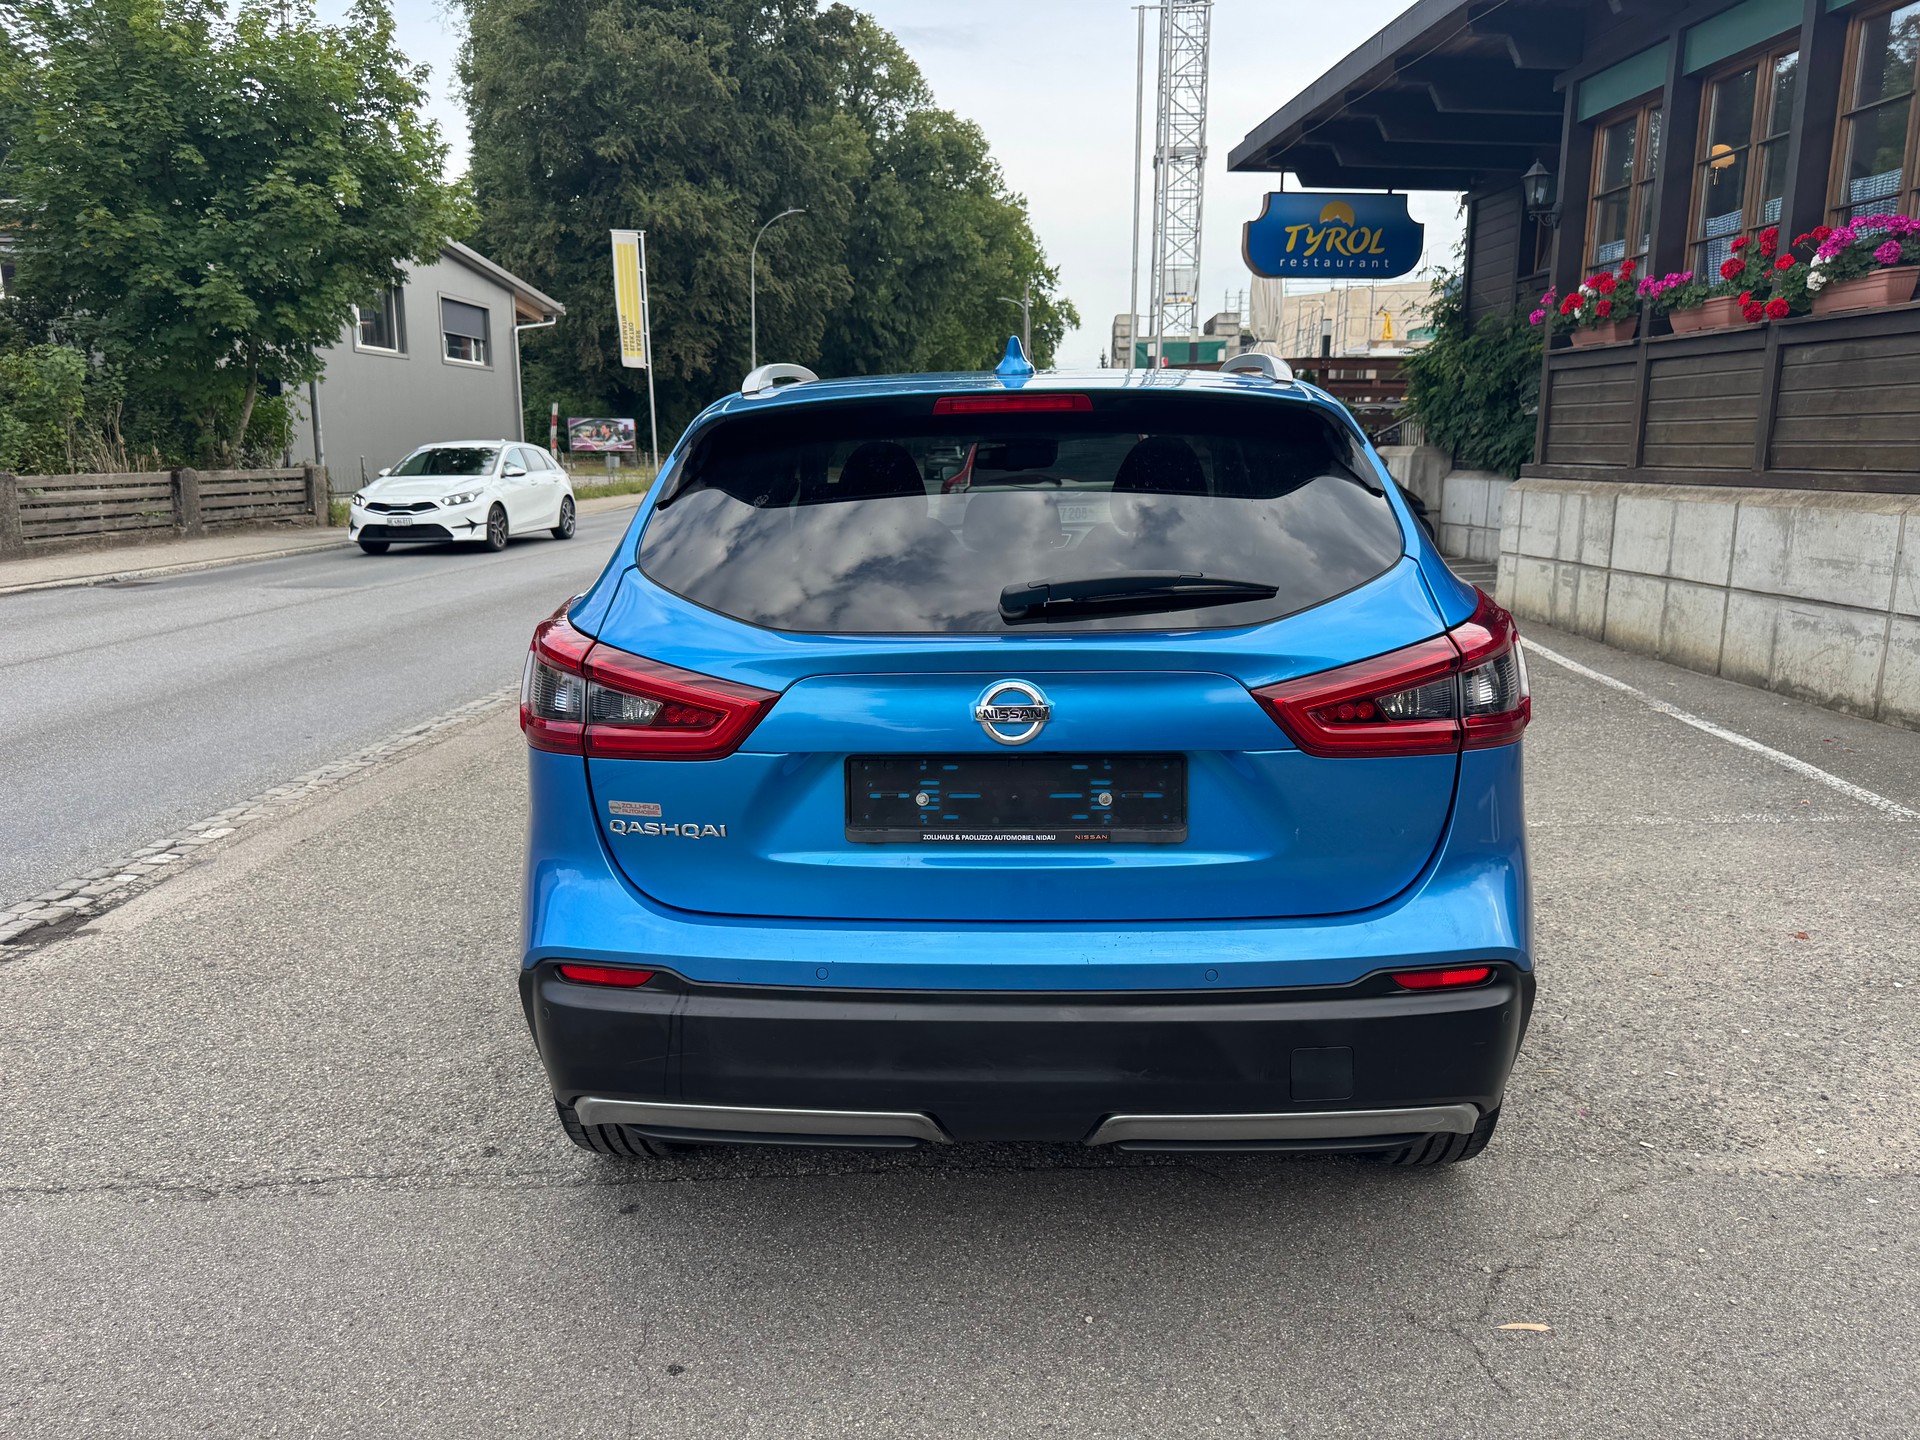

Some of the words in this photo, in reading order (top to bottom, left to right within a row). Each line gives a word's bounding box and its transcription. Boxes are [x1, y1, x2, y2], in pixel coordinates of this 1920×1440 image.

[1284, 223, 1386, 257] TYROL
[1279, 257, 1390, 268] restaurant
[983, 709, 1041, 719] NISSAN
[609, 819, 727, 839] QASHQAI
